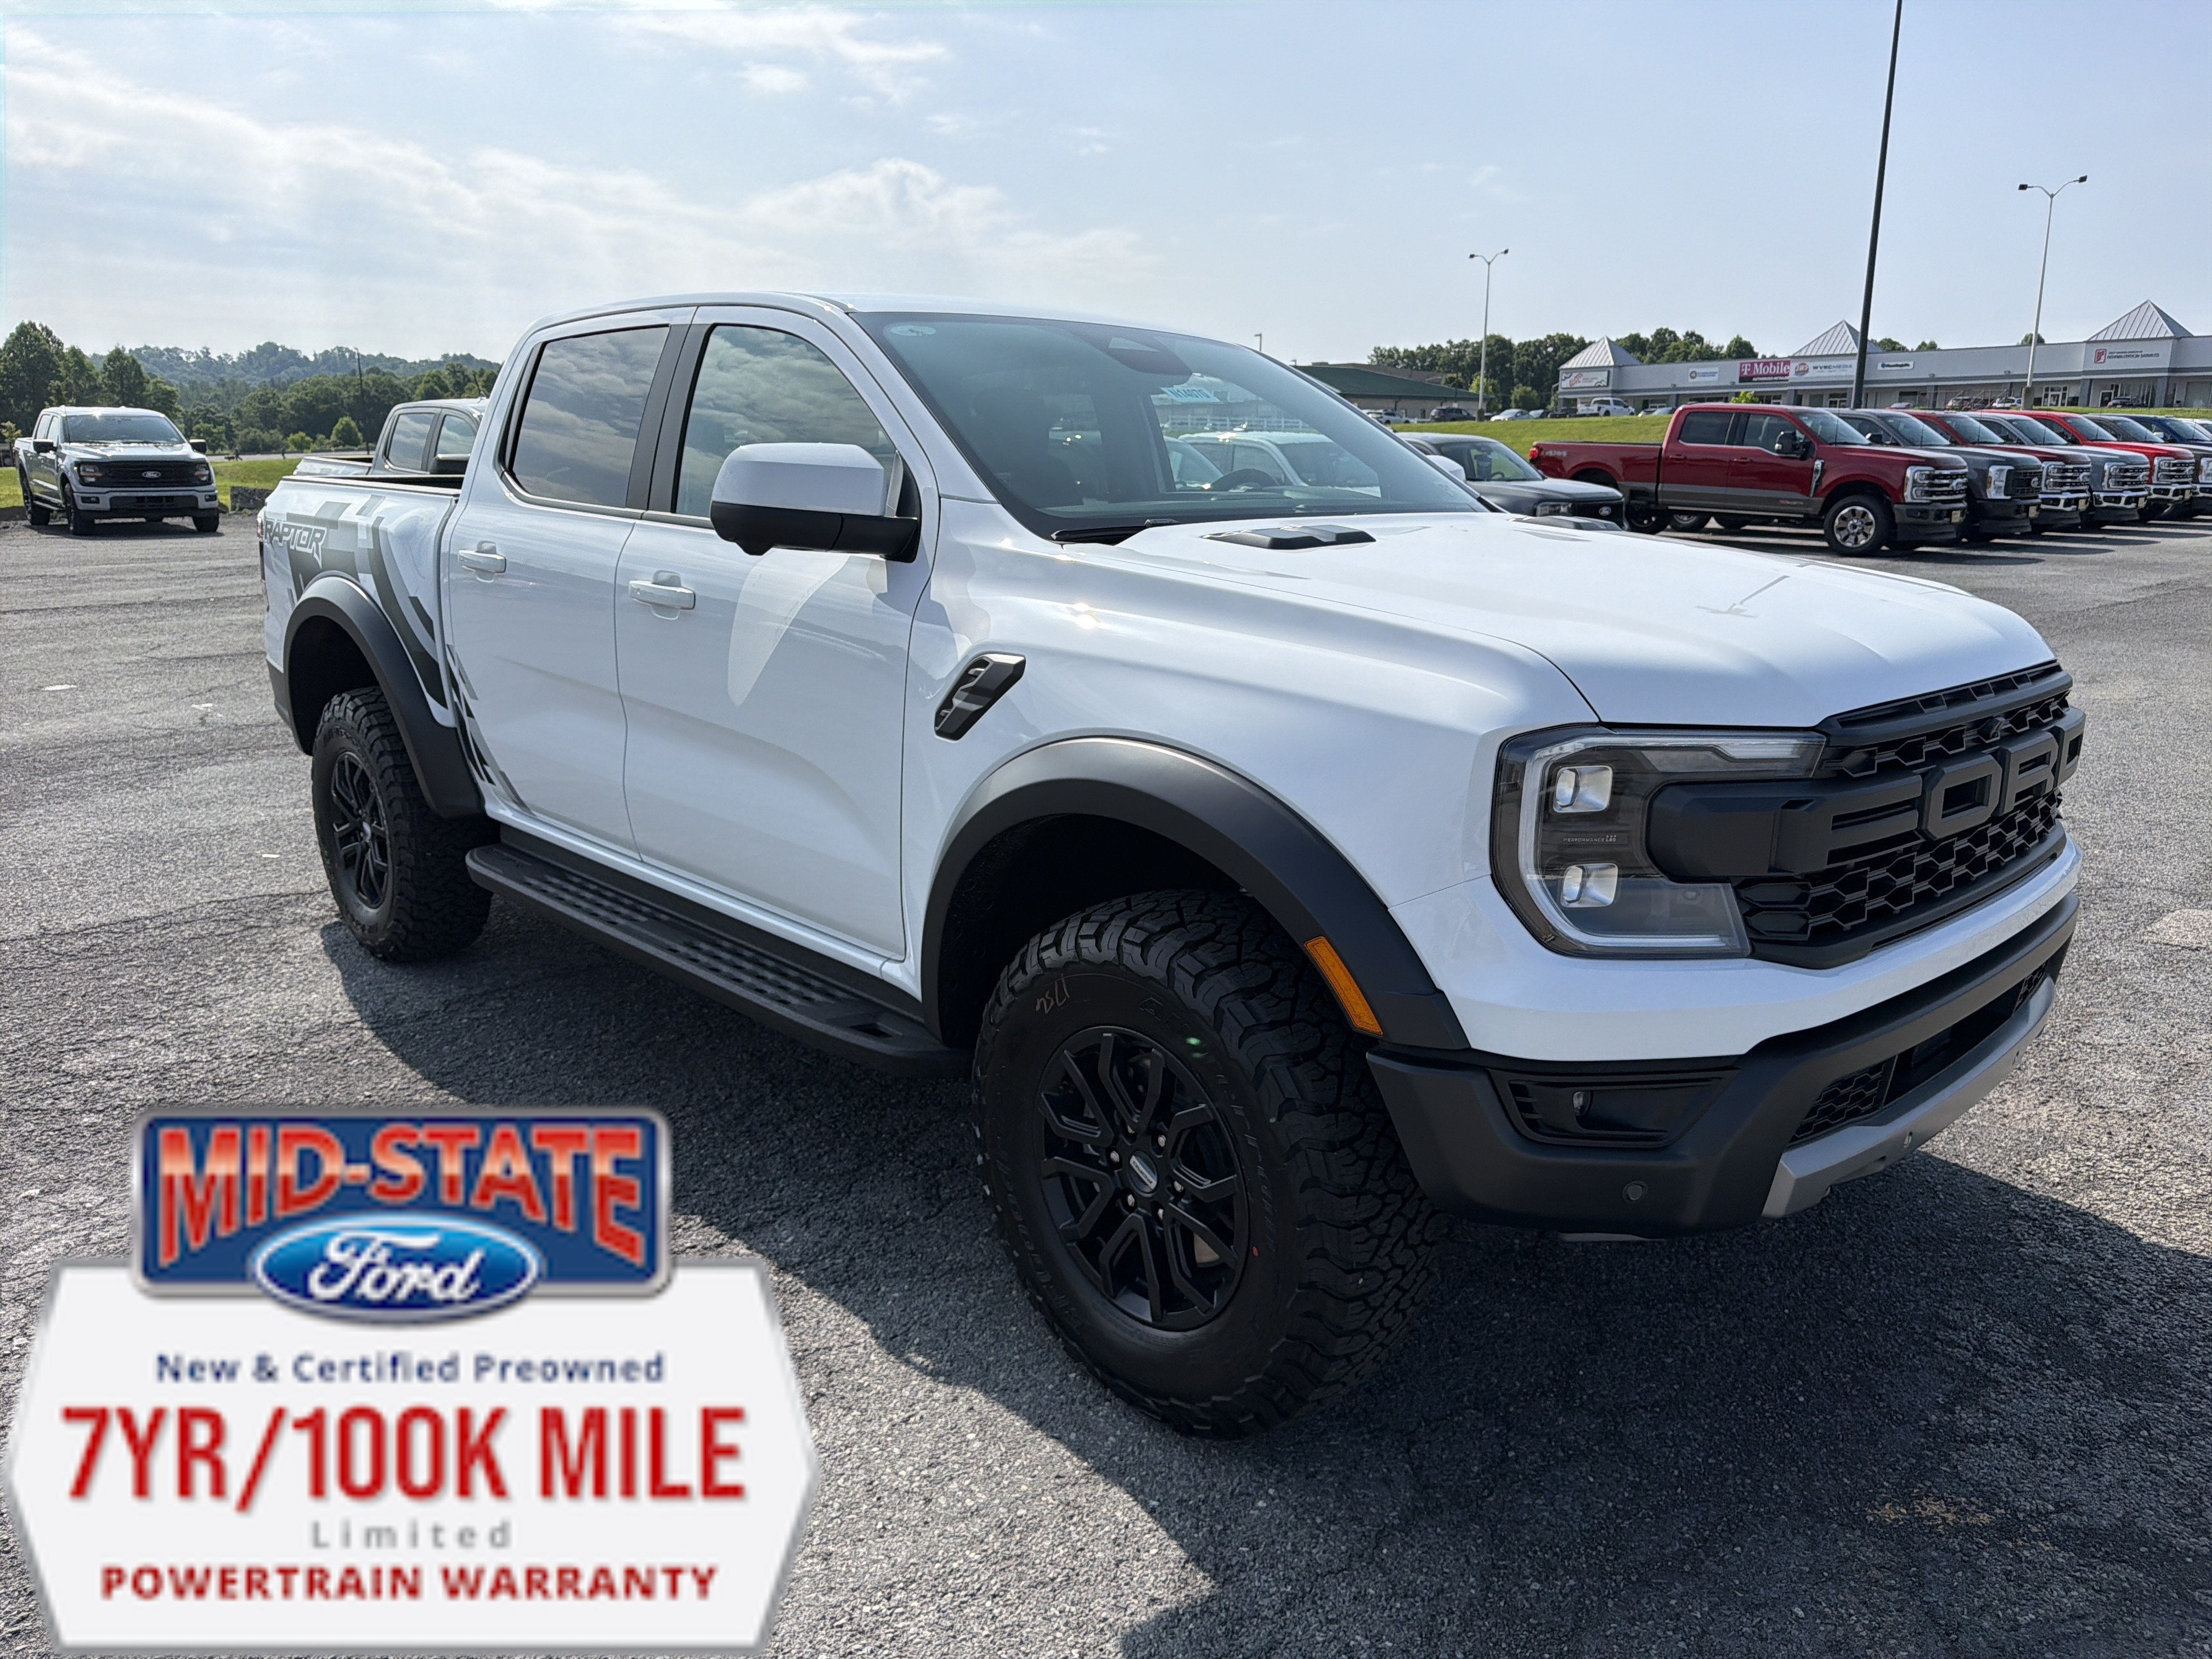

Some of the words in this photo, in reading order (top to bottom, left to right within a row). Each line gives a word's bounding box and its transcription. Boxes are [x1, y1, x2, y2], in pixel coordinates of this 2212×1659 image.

[1753, 362, 1790, 375] Mobile
[264, 519, 326, 569] RAPTOR
[1771, 705, 2086, 874] FORD
